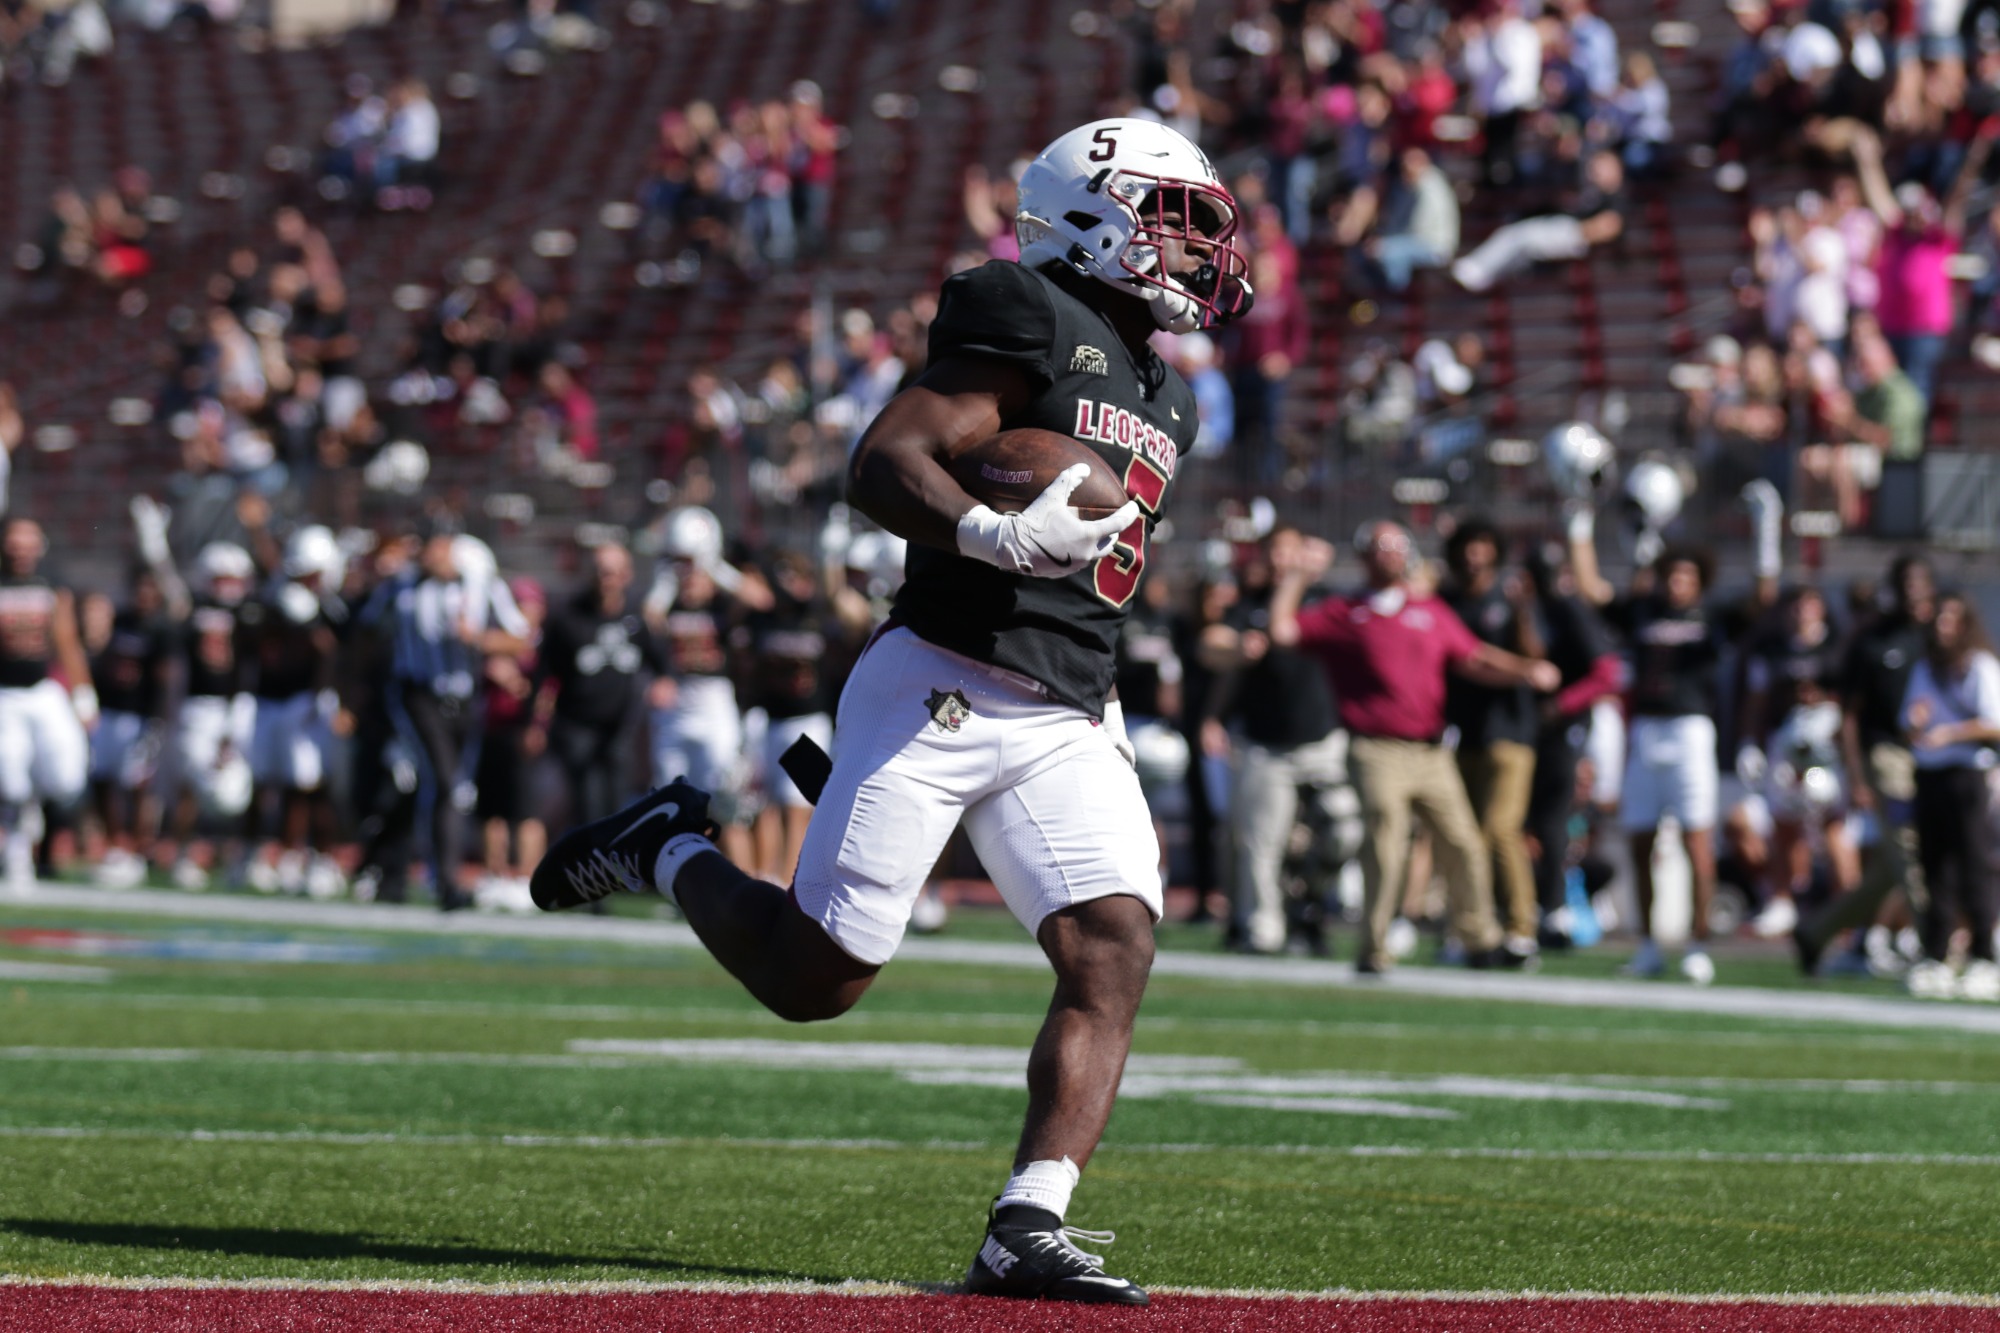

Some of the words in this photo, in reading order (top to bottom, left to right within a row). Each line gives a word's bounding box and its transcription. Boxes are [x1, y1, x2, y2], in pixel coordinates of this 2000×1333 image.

[1088, 127, 1122, 162] 5
[1094, 453, 1168, 609] 5
[979, 1233, 1020, 1278] NIKE
